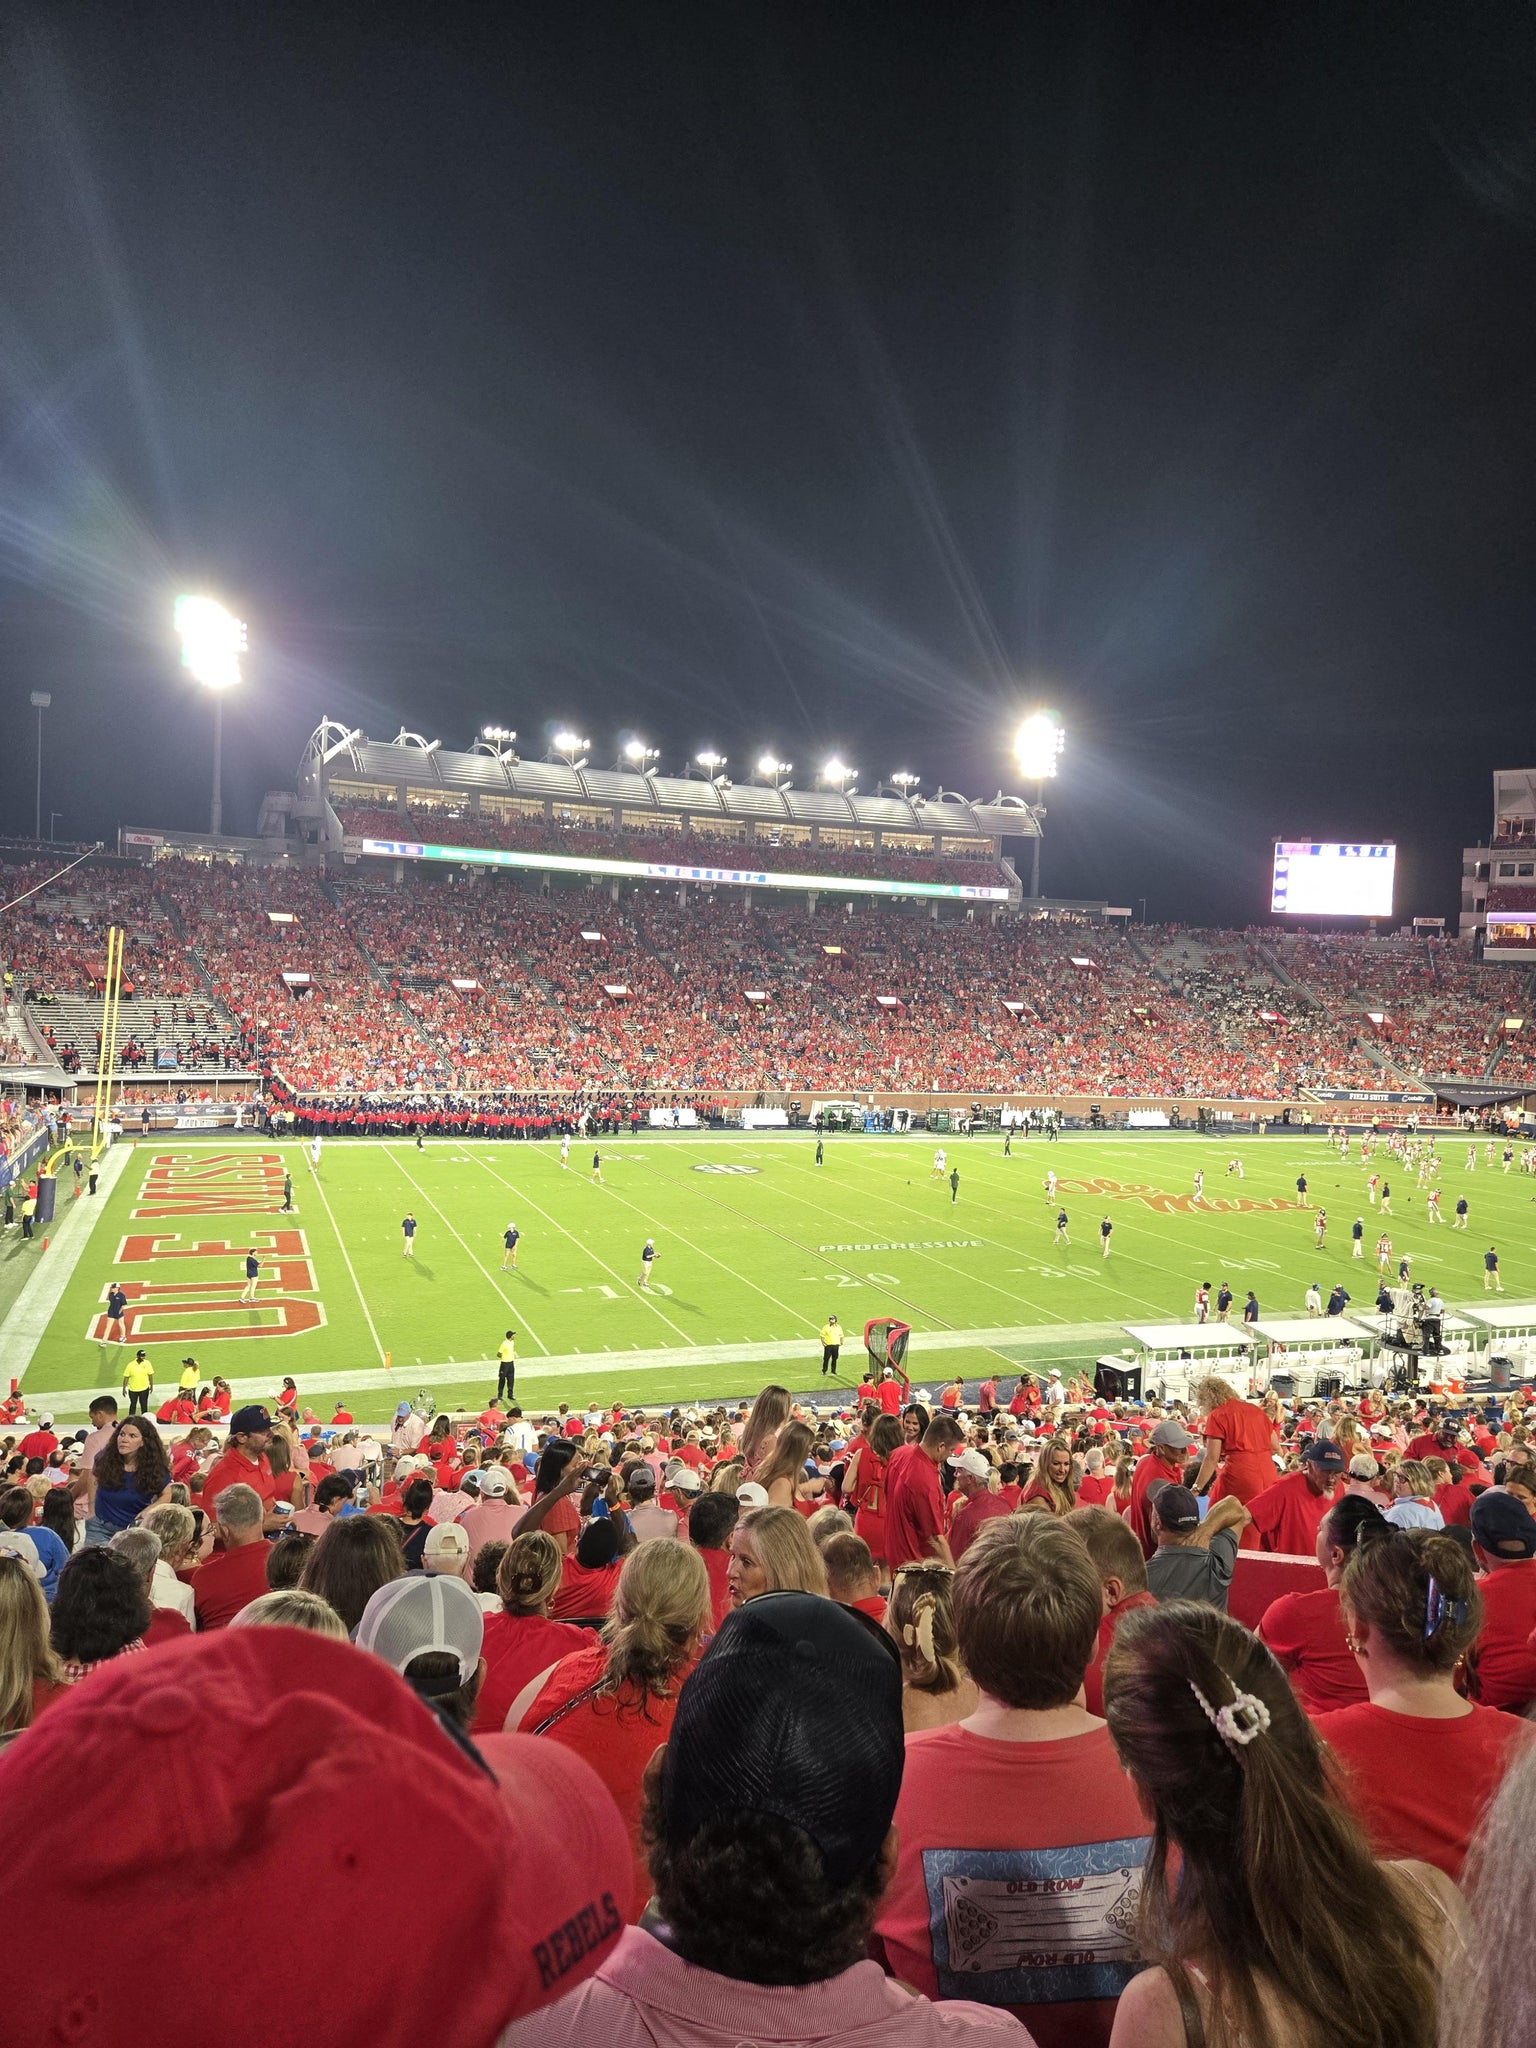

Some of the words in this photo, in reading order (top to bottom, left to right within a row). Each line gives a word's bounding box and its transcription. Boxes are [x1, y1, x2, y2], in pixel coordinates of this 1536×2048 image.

[1369, 1093, 1389, 1101] SUITE
[694, 1164, 759, 1175] SEC
[129, 1154, 300, 1219] MISS
[1042, 1178, 1163, 1201] Ole
[1110, 1193, 1326, 1215] Miss
[819, 1239, 985, 1252] PROGRESSIVE
[1028, 1264, 1102, 1278] 30
[824, 1272, 901, 1287] 20
[85, 1229, 328, 1346] OLE
[588, 1283, 674, 1299] 10
[1006, 1880, 1038, 1894] OLD
[1043, 1878, 1085, 1892] ROW
[531, 1891, 621, 1989] REBELS
[1017, 1953, 1058, 1967] ROW
[1063, 1952, 1095, 1965] OLD
